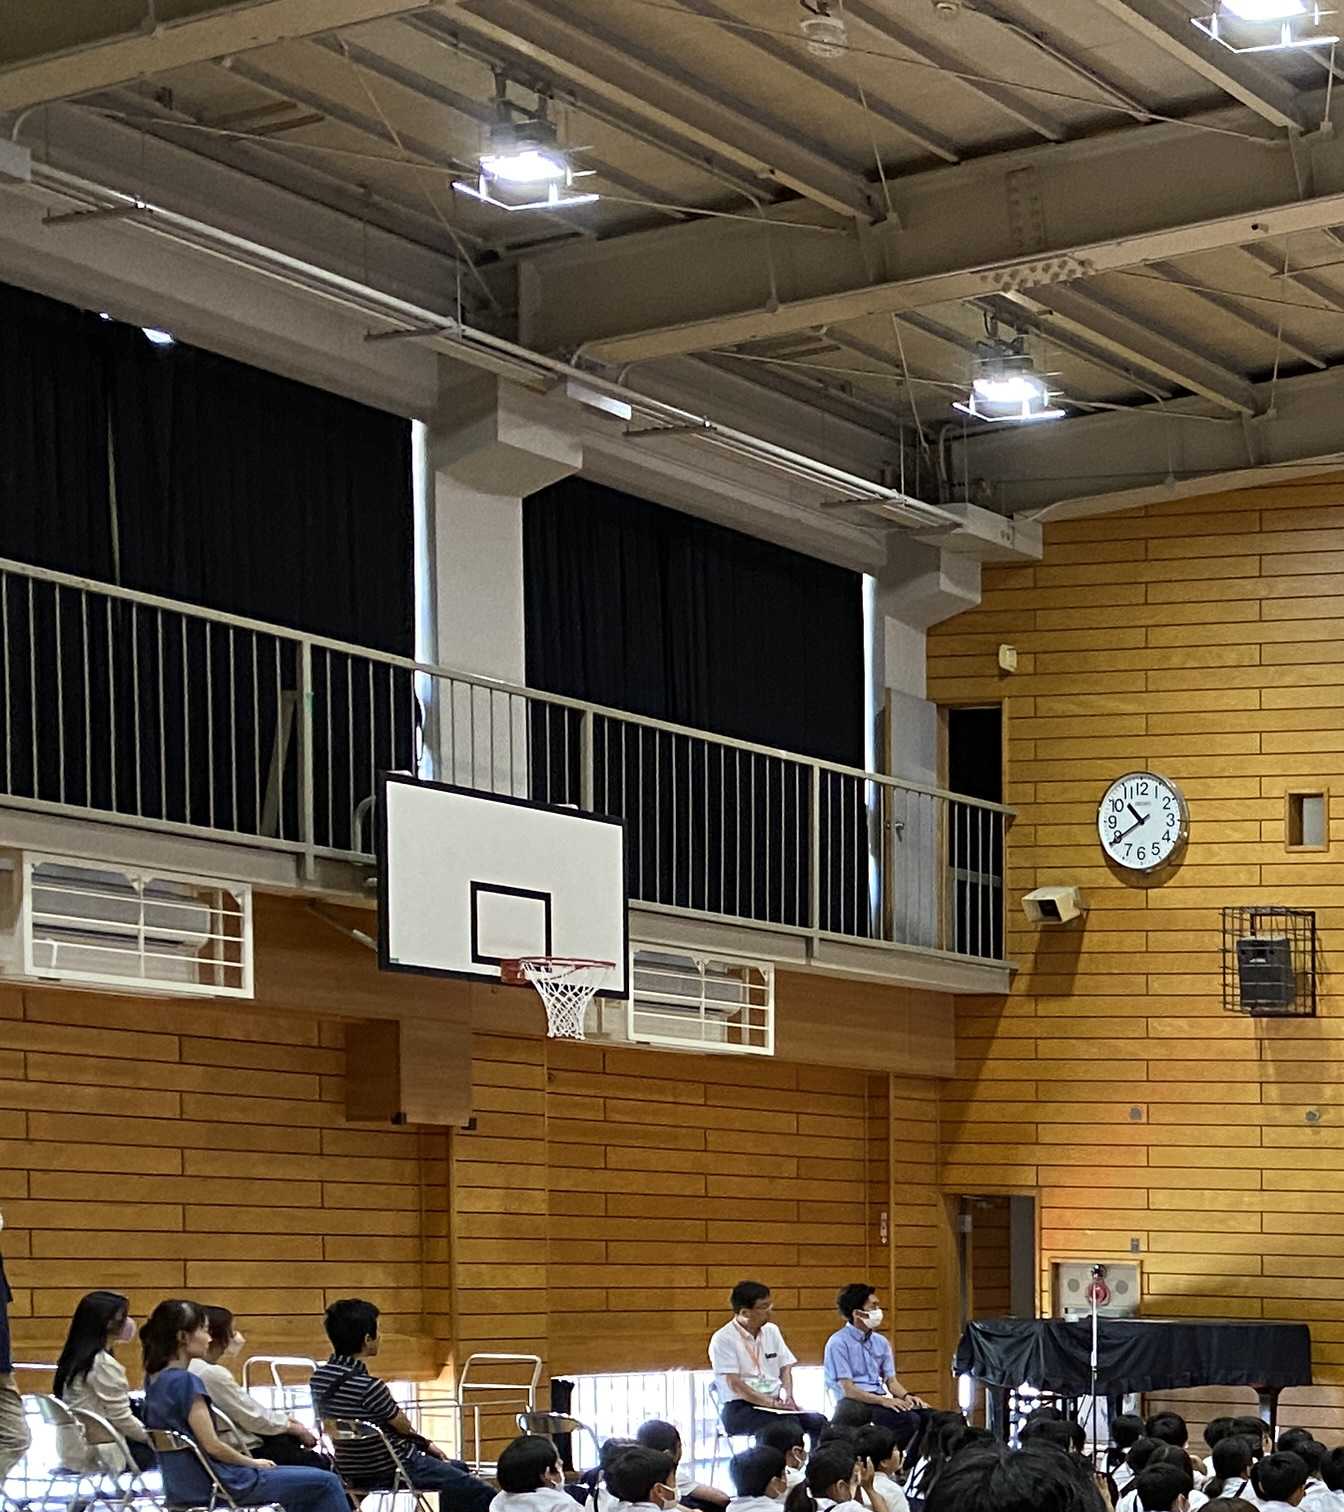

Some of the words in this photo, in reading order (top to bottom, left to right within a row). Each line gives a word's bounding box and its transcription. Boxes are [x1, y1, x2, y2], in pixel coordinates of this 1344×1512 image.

[1124, 785, 1133, 799] 11
[1136, 782, 1149, 796] 12
[1109, 798, 1124, 812] 10
[1162, 796, 1171, 810] 2
[1108, 815, 1117, 829] 9
[1166, 813, 1175, 827] 3
[1113, 830, 1122, 844] 8
[1161, 829, 1171, 842] 4
[1124, 843, 1133, 856] 7
[1137, 846, 1146, 860] 6
[1151, 842, 1160, 856] 5
